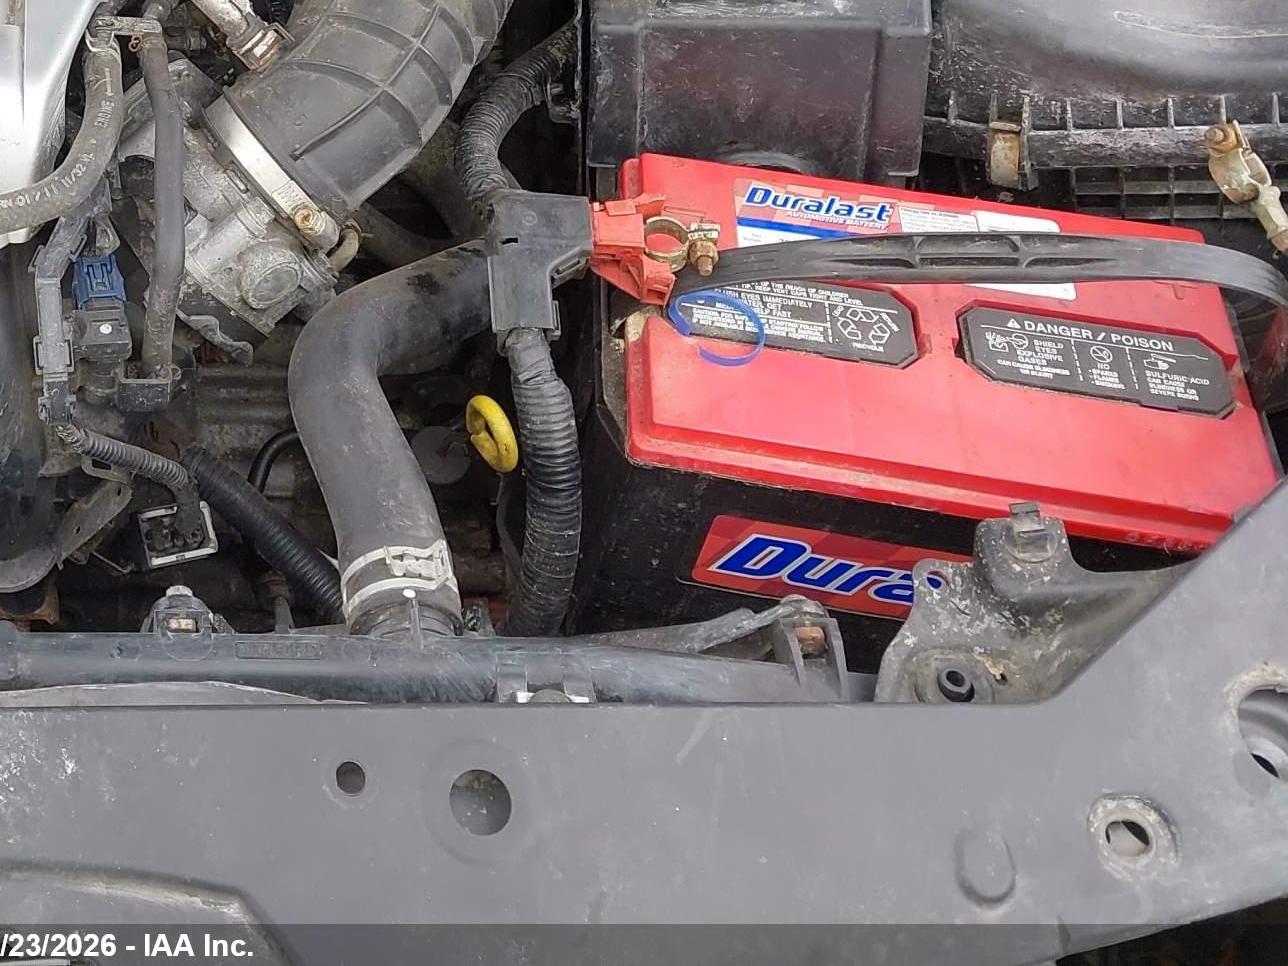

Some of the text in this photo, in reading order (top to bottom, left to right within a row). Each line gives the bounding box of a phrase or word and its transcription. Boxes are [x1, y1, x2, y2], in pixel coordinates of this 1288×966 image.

[744, 185, 895, 222] Duralast
[786, 210, 845, 225] AUTOMOTIVE
[845, 219, 889, 231] BATTERY
[741, 293, 760, 301] EYES
[762, 295, 813, 309] IMMEDIATELY
[772, 309, 792, 318] FAST
[1023, 320, 1094, 340] DANGER
[1110, 333, 1174, 352] POISON
[852, 342, 885, 353] RECYCLE
[1033, 339, 1064, 349] SHIELD
[1034, 345, 1058, 355] EYES
[1016, 349, 1064, 362] EXPLOSIVE
[1017, 355, 1048, 366] GASES
[1097, 362, 1111, 371] NO
[1144, 369, 1210, 386] SULFURIC ACID
